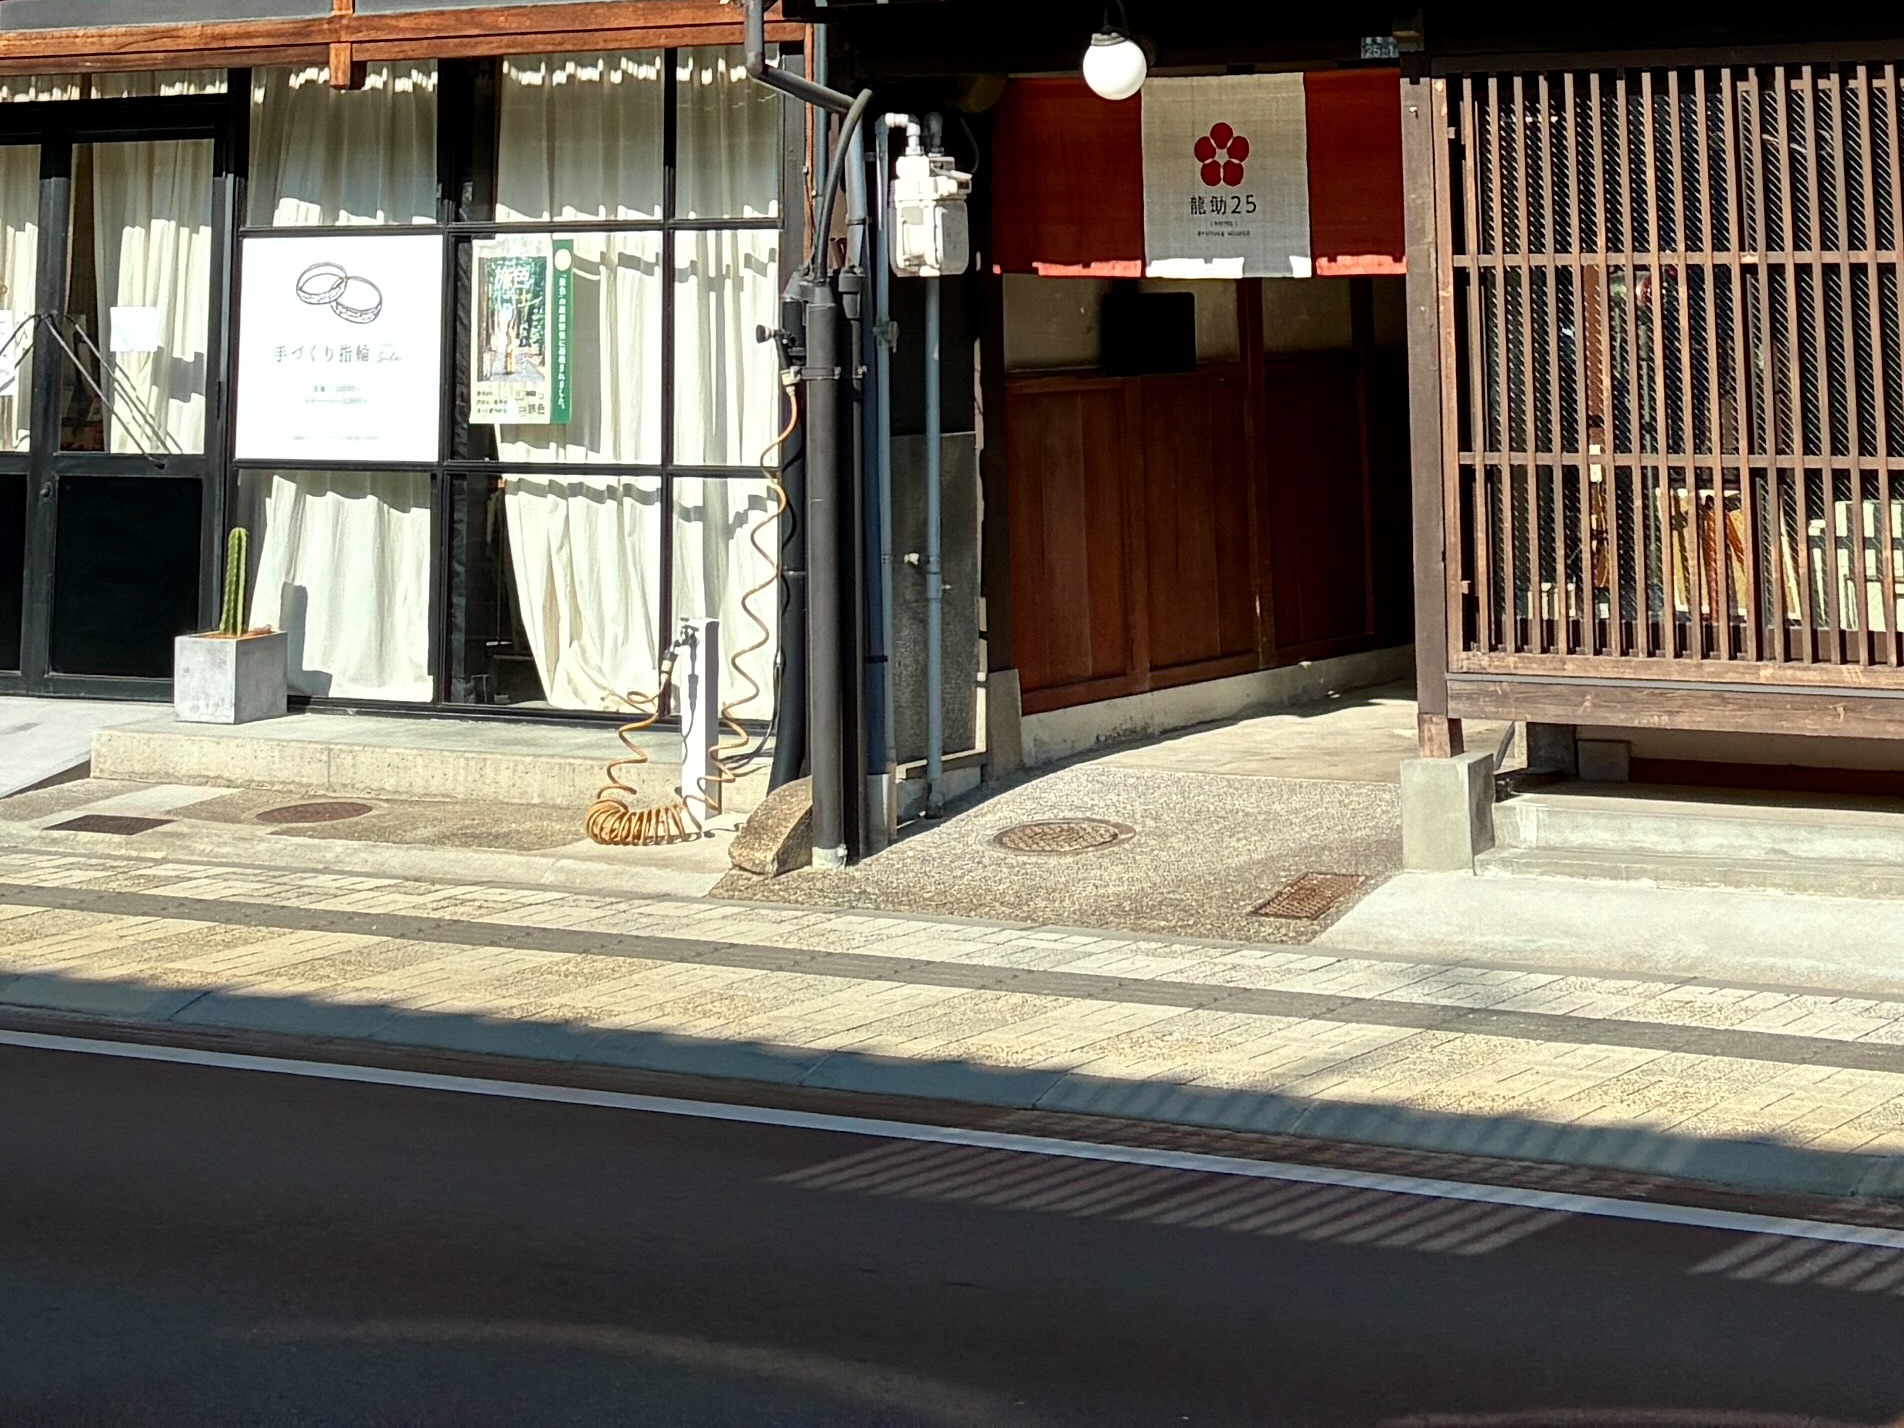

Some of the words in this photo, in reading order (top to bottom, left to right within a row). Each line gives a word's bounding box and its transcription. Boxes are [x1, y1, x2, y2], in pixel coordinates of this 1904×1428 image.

[274, 344, 370, 363] 手づくり指輪
